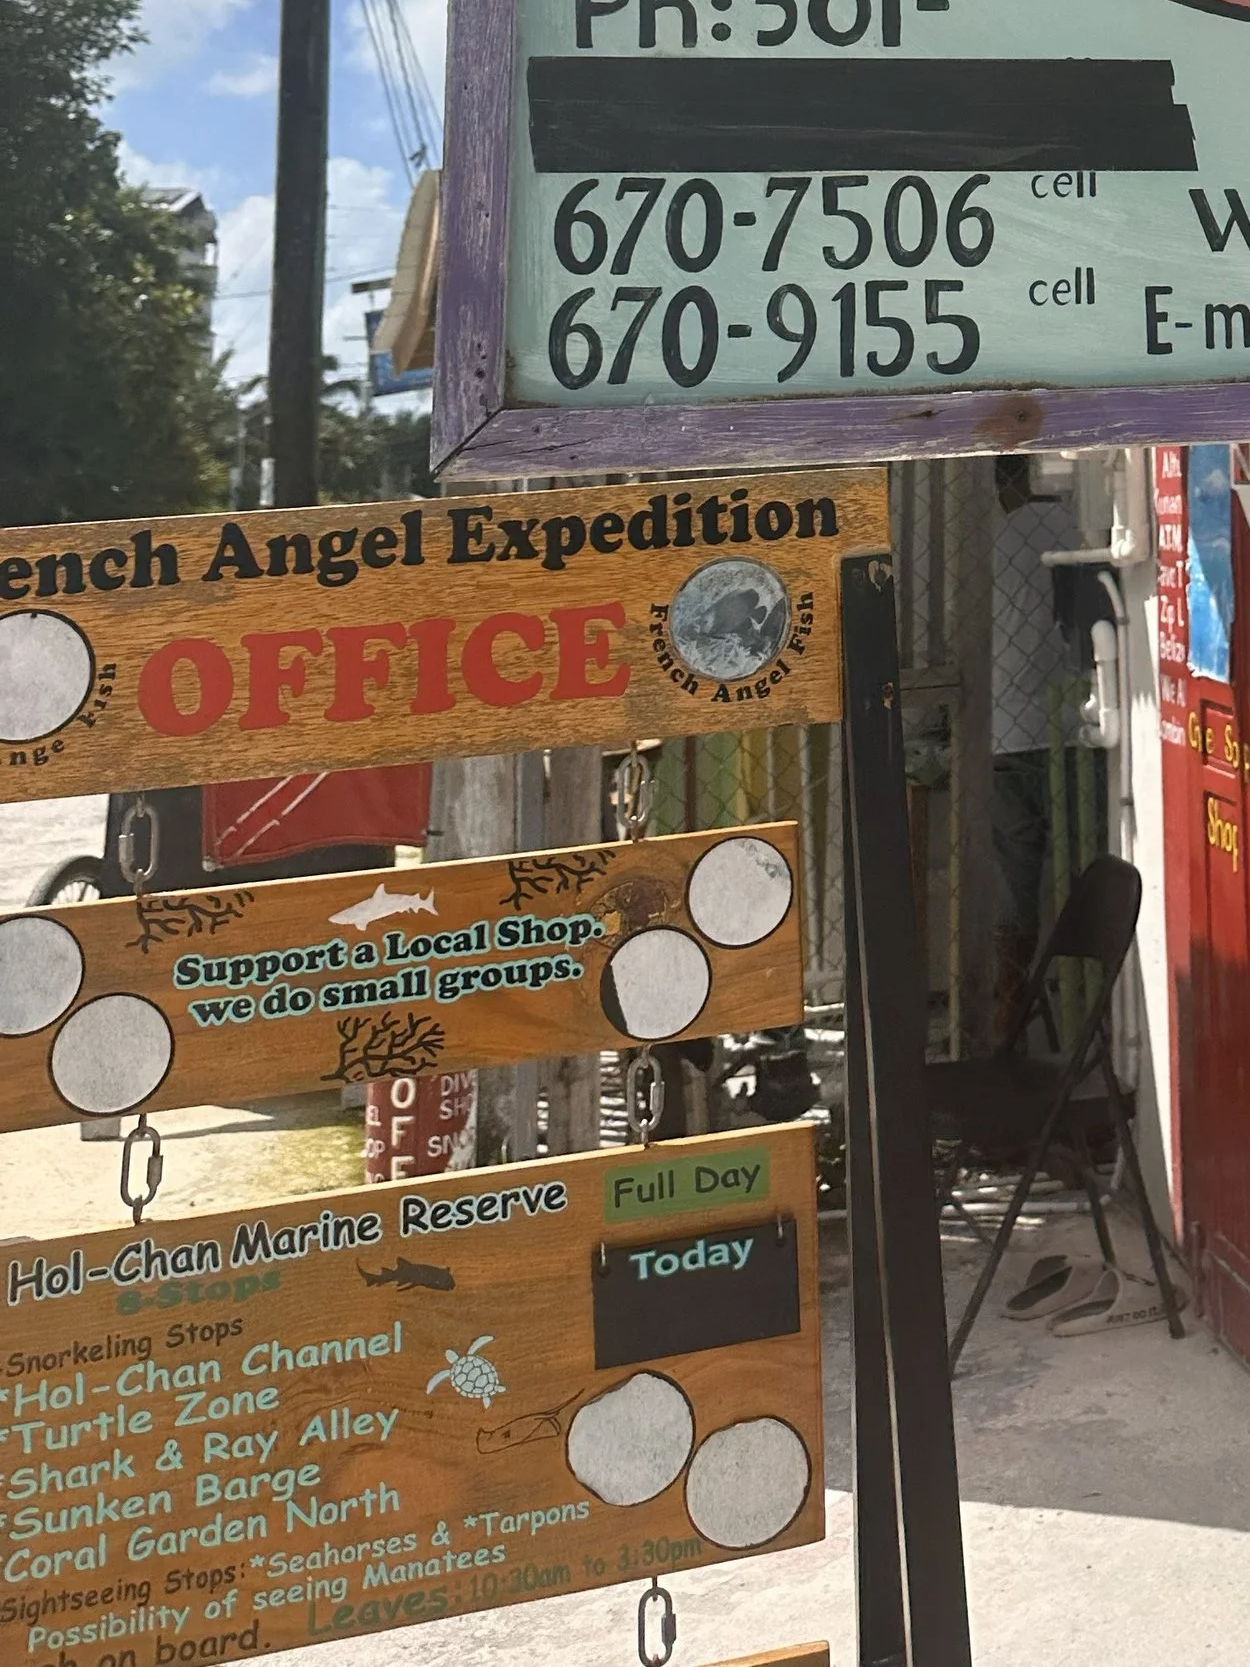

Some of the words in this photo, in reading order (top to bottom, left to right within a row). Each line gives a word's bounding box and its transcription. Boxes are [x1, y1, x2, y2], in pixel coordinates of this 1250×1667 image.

[553, 173, 996, 275] 670-7506
[1030, 170, 1097, 199] cell
[547, 279, 981, 390] 670-9155
[1028, 266, 1096, 306] cell
[202, 509, 426, 588] Angel
[447, 488, 840, 571] Expedition
[137, 602, 631, 737] OFFICE
[649, 603, 700, 696] French
[710, 659, 792, 703] Angel
[786, 591, 814, 656] Fish
[174, 940, 345, 988] Support
[354, 943, 377, 966] a
[386, 924, 486, 960] Local
[496, 914, 603, 948] Shop.
[191, 997, 253, 1025] we
[264, 986, 312, 1018] do
[321, 968, 428, 1009] small
[439, 955, 582, 1002] groups.
[613, 1169, 675, 1208] Full
[694, 1163, 761, 1194] Day
[8, 1238, 222, 1307] Hol-Chan
[230, 1209, 384, 1269] Marine
[400, 1181, 568, 1239] Reserve
[629, 1237, 754, 1281] Today
[165, 1317, 244, 1348] Stops
[241, 1320, 403, 1377] Channel
[154, 1438, 184, 1472] &
[203, 1429, 279, 1464] Ray
[298, 1406, 400, 1447] Alley
[174, 1386, 281, 1427] Zone
[195, 1462, 321, 1504] Barge
[127, 1512, 268, 1562] Garden
[286, 1481, 401, 1534] North
[430, 1521, 452, 1547] &
[27, 1605, 191, 1654] Possibility
[204, 1588, 238, 1620] of
[252, 1574, 348, 1611] seeing
[361, 1541, 506, 1591] Manatees
[582, 1554, 607, 1579] to
[155, 1618, 272, 1666] board.
